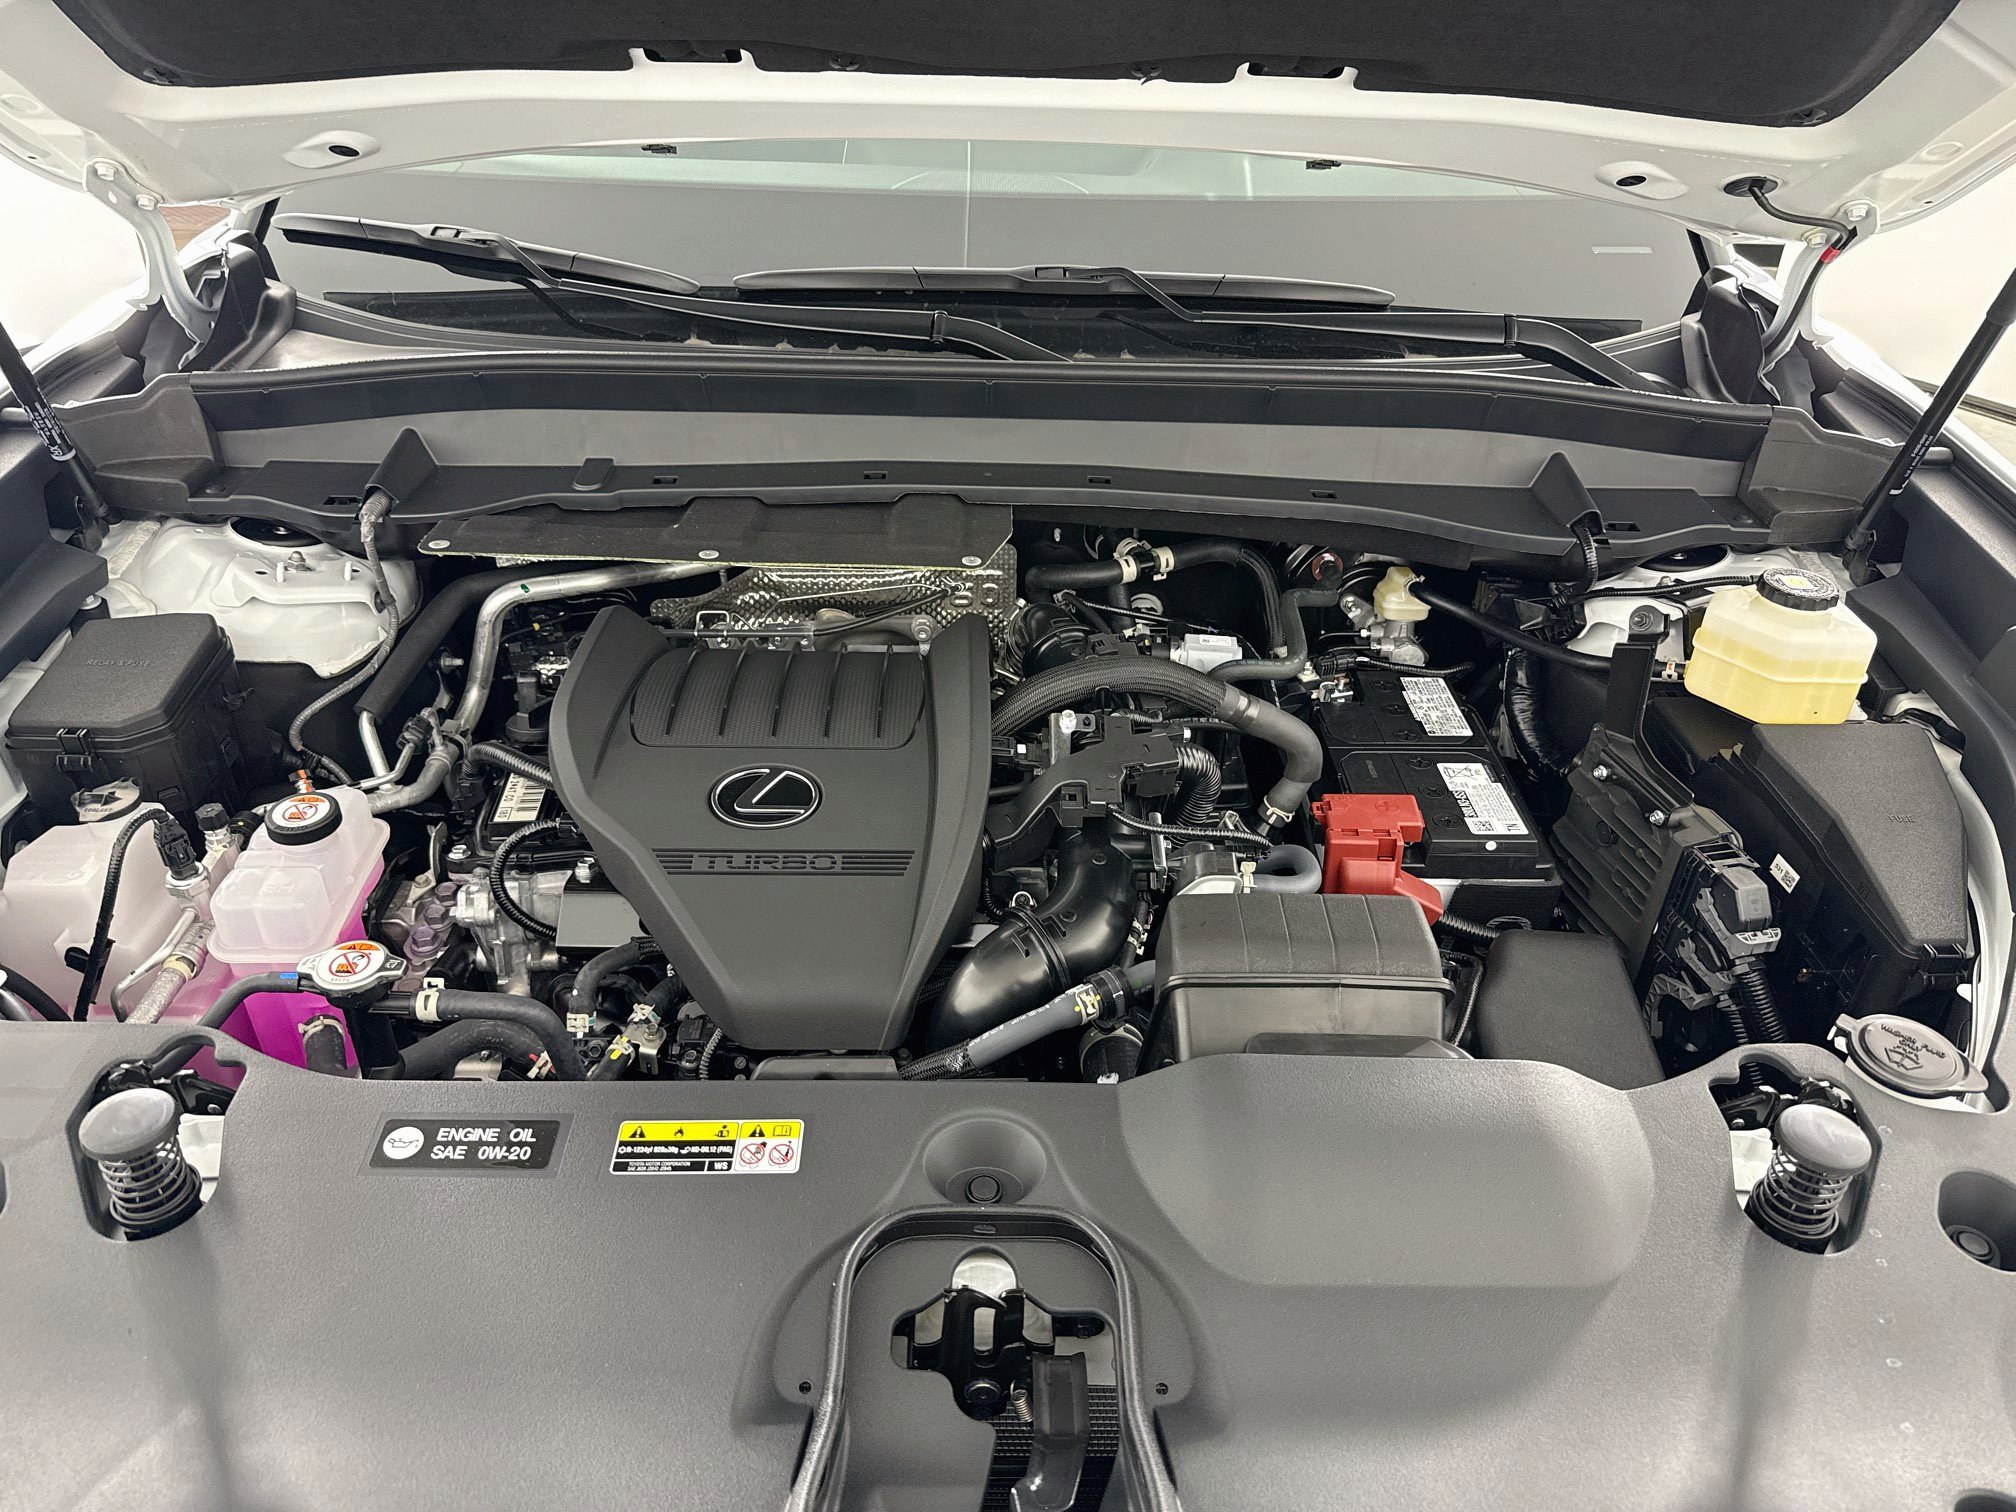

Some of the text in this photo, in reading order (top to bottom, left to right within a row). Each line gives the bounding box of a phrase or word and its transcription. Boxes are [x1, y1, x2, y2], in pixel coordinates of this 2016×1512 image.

[86, 659, 116, 667] RELAY
[126, 660, 151, 668] FUSE
[1888, 813, 1915, 823] FUSE
[697, 853, 838, 870] TURBO
[1880, 1024, 1946, 1059] WASHER FLUID
[1898, 1039, 1923, 1052] ONLY
[436, 1127, 537, 1142] ENGINE OIL
[430, 1145, 532, 1160] SAE 0W-20
[714, 1162, 728, 1170] WS
